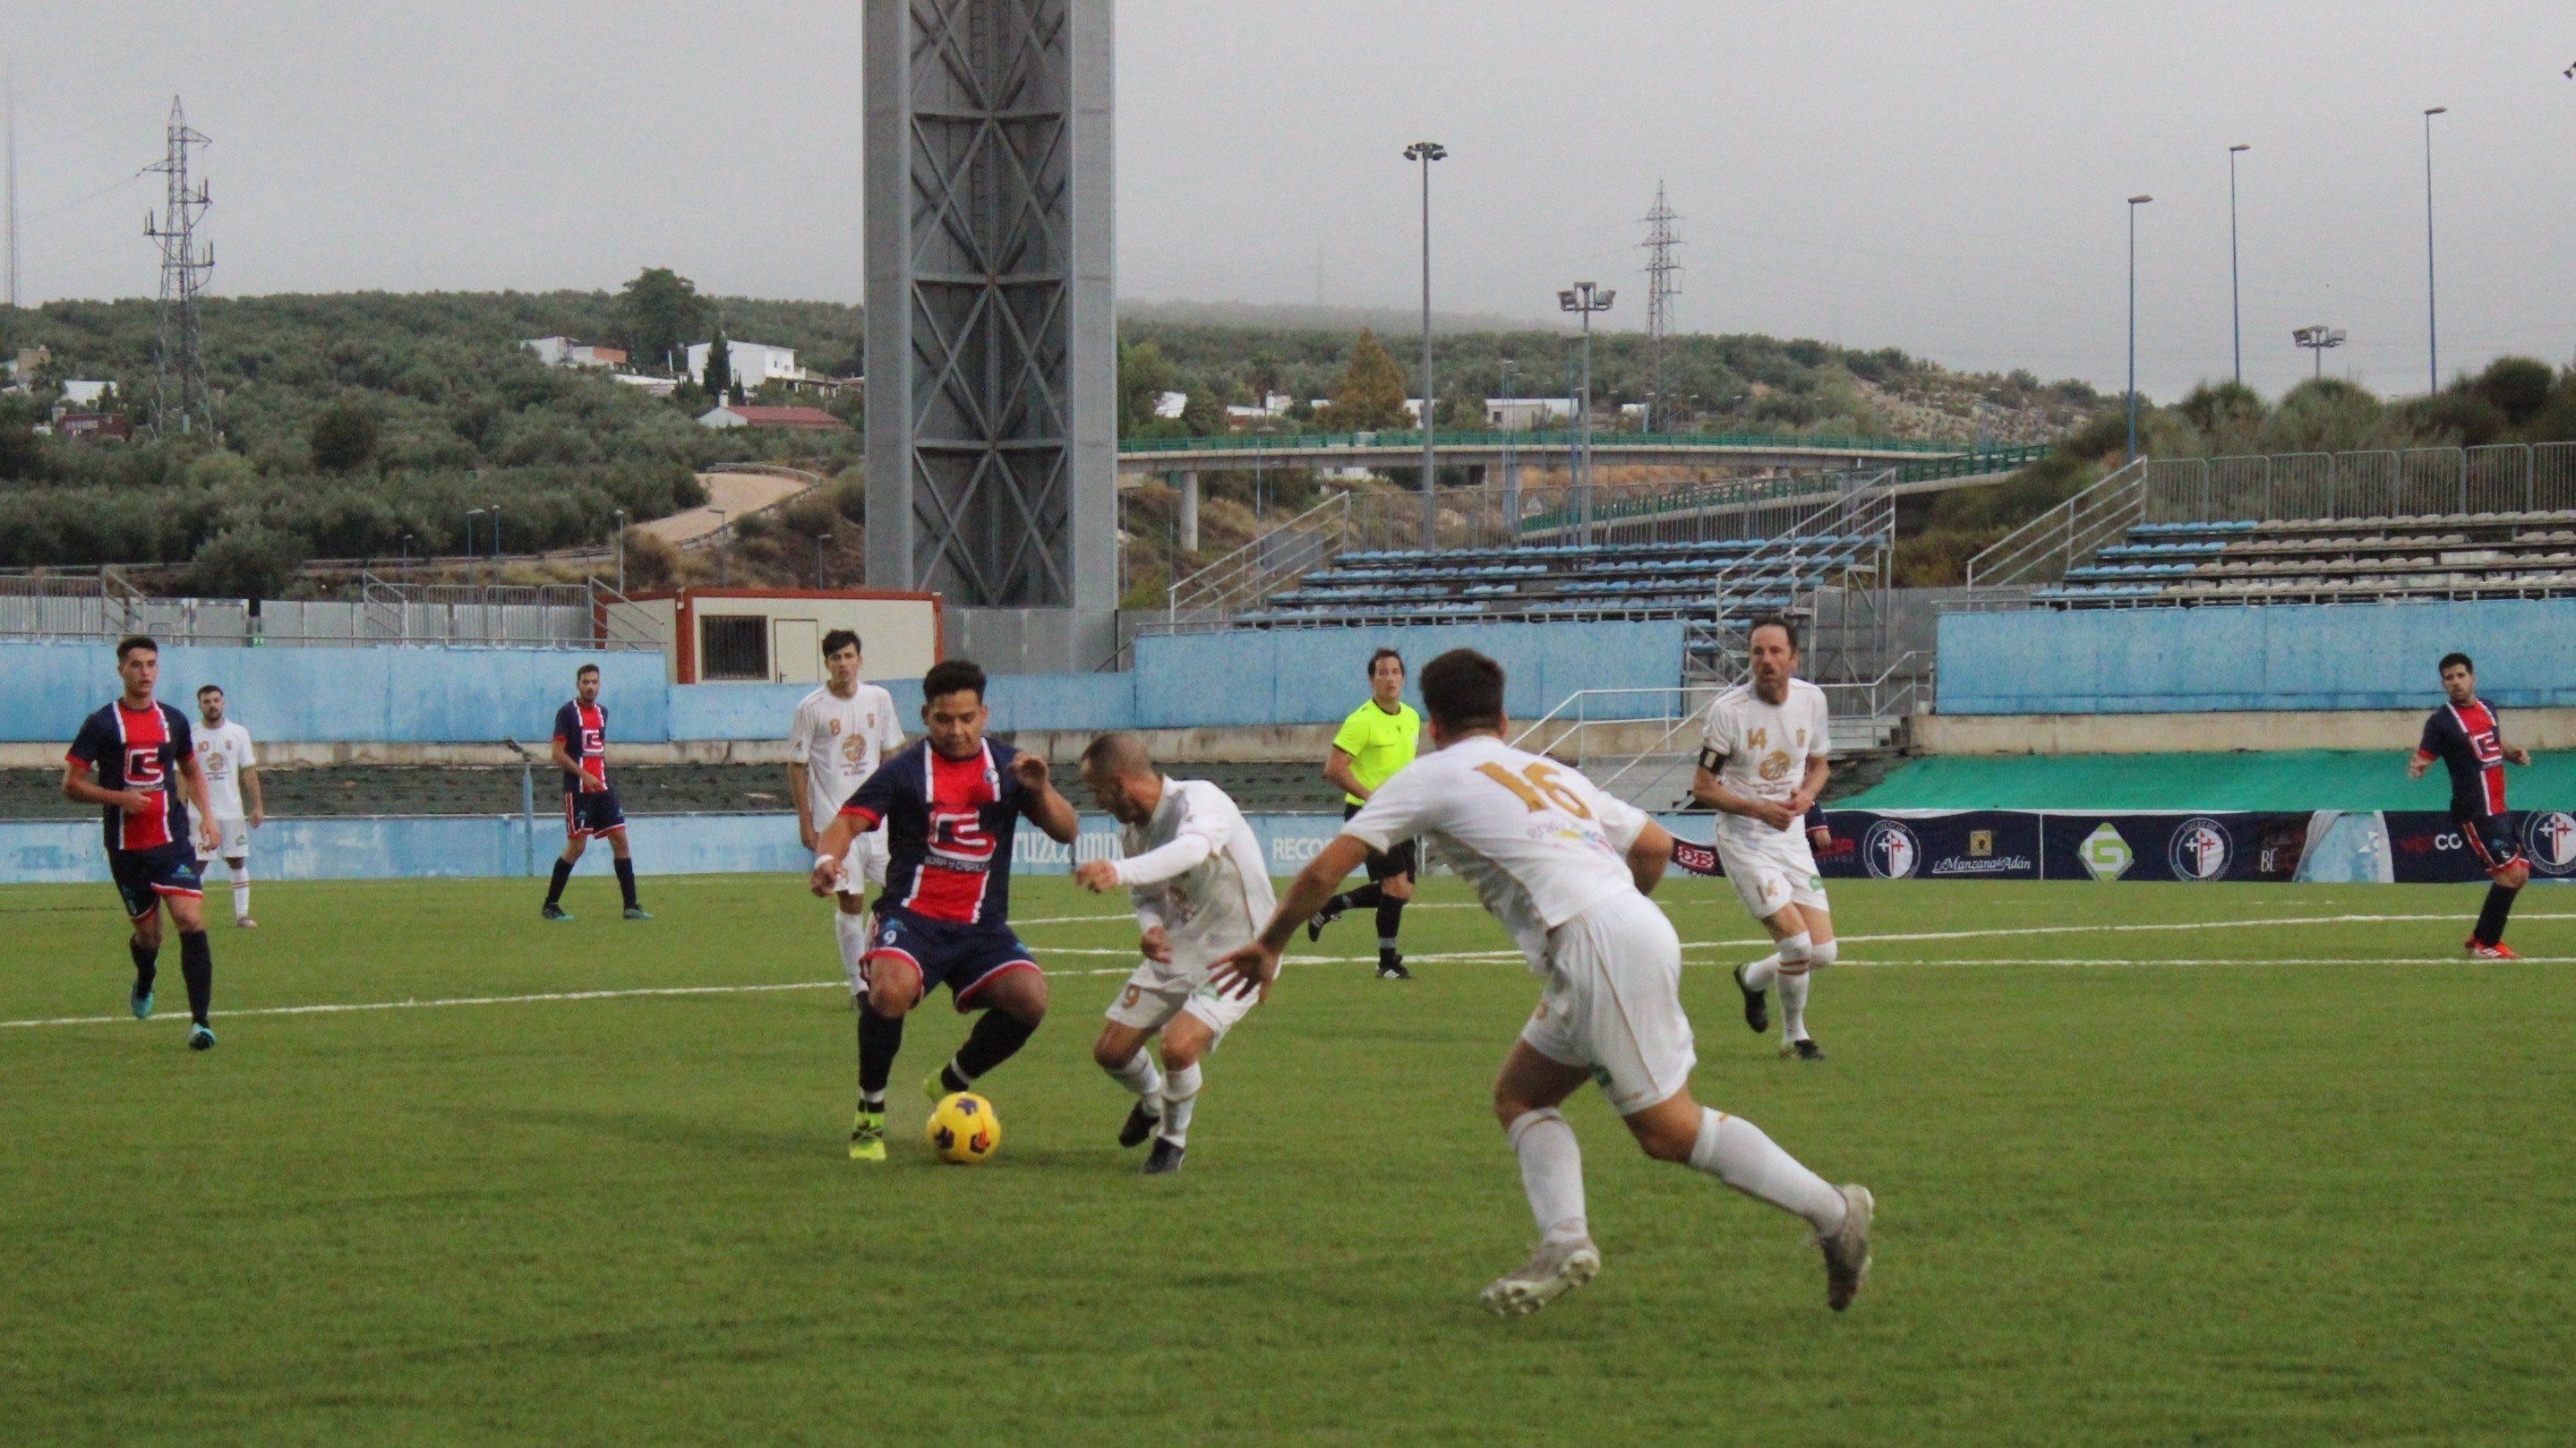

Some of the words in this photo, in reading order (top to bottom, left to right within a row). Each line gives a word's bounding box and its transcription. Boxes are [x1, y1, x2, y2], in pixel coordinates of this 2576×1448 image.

[829, 718, 841, 735] 8
[197, 741, 210, 752] 10
[1747, 727, 1767, 750] 14
[1472, 760, 1595, 820] 16
[1944, 855, 1997, 871] Manzana
[2002, 854, 2032, 870] Adán
[1757, 879, 1778, 904] 14
[883, 930, 897, 945] 9
[1122, 983, 1141, 1008] 9
